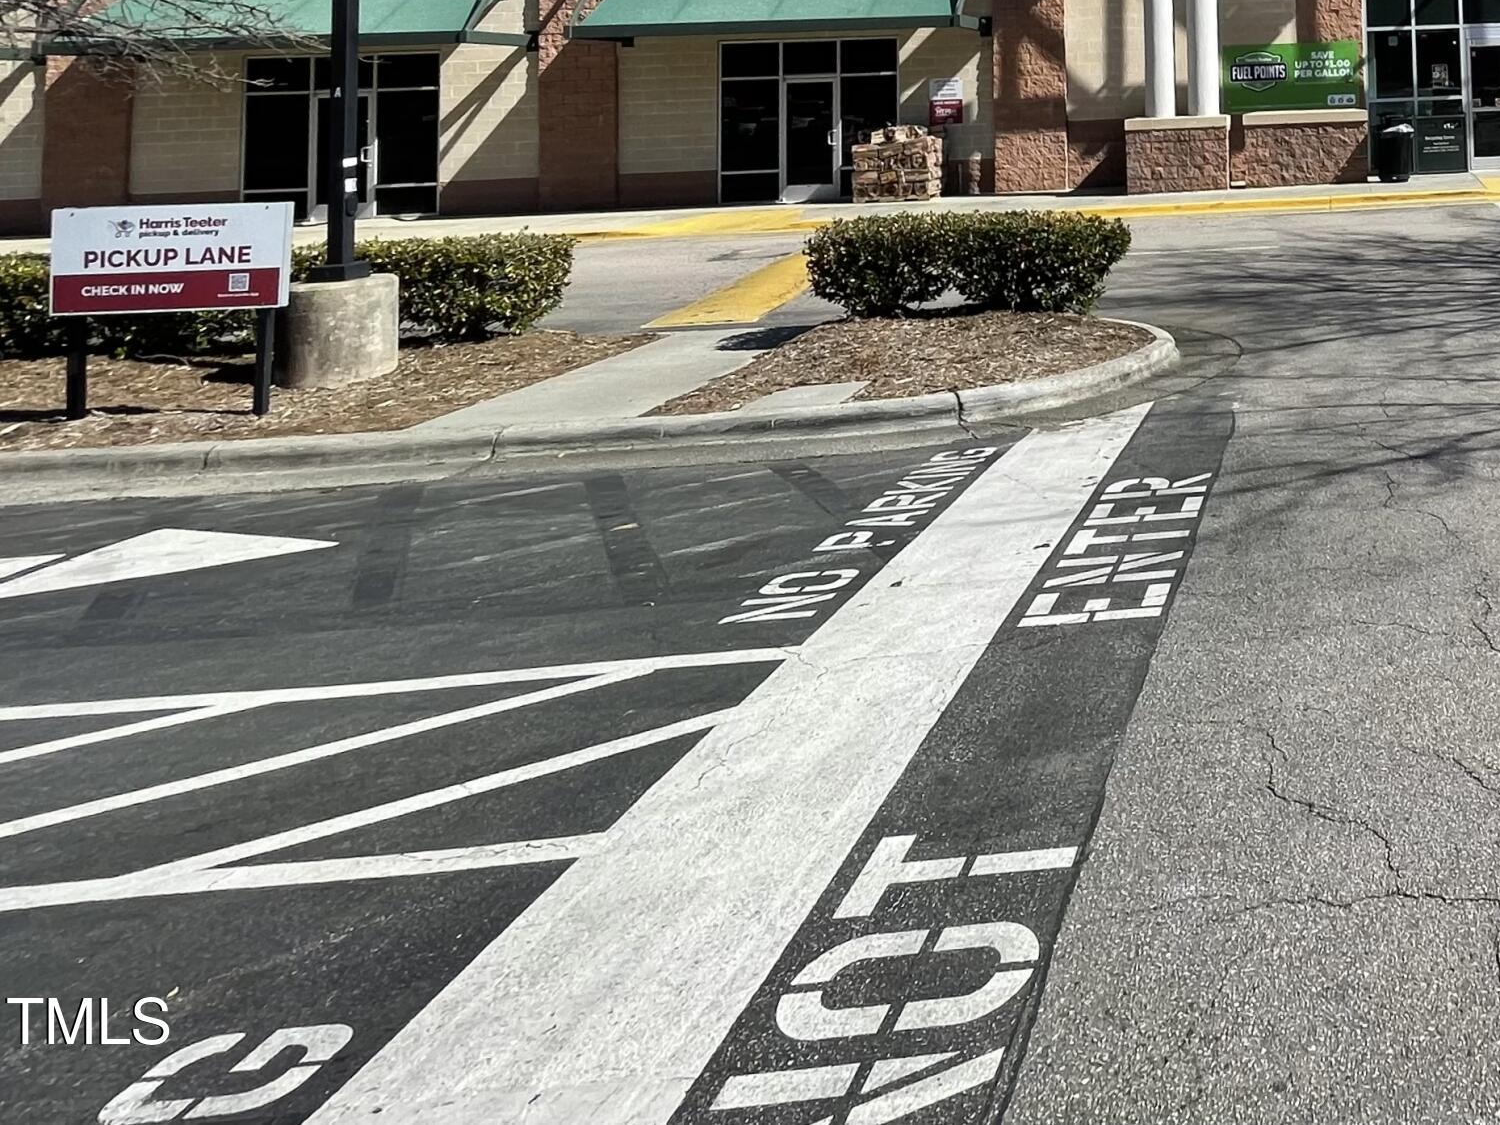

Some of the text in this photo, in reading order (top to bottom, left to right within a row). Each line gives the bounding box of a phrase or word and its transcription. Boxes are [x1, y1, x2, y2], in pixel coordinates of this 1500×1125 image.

[1311, 50, 1335, 60] SAVE
[1294, 60, 1309, 69] UP
[1310, 59, 1324, 68] TO
[1232, 65, 1286, 80] FUEL POINTS
[1294, 67, 1354, 79] PER GALLON
[139, 216, 228, 229] Harris Teeter
[138, 230, 171, 239] pickup
[181, 229, 219, 237] delivery
[83, 245, 252, 269] PICKUP LANE
[81, 282, 185, 297] CHECK IN NOW
[717, 446, 998, 625] NO PARKING
[1016, 472, 1213, 628] ENTER
